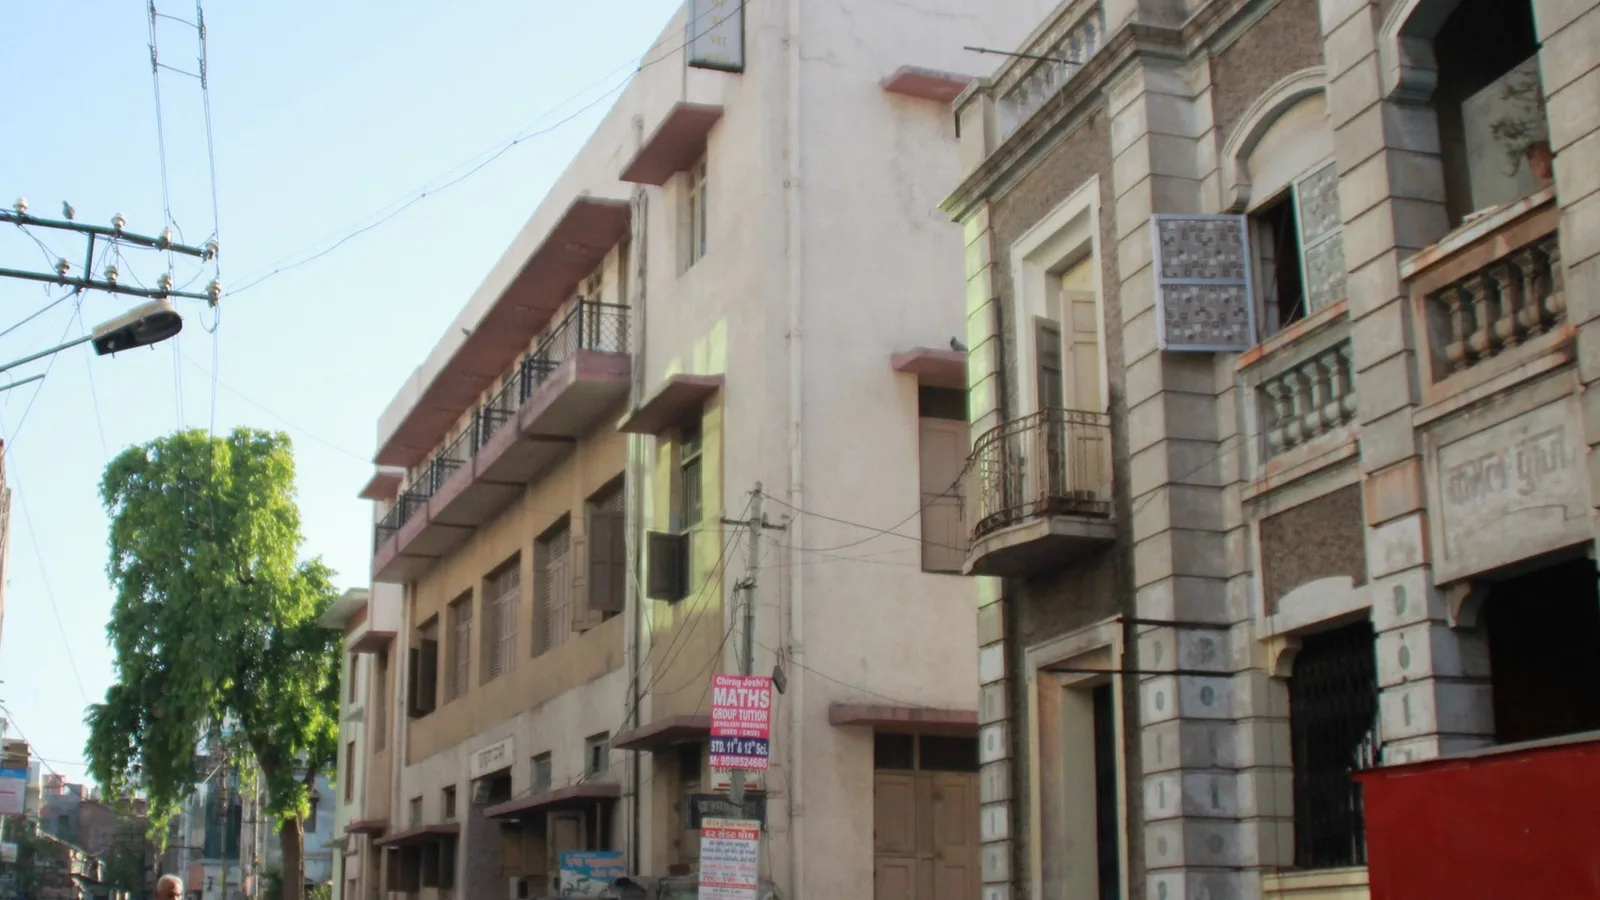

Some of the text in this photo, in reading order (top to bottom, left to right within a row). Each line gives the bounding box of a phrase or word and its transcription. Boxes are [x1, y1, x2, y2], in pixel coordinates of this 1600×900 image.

[716, 676, 769, 688] Chirag Joshi's
[713, 687, 770, 708] MATHS
[712, 707, 768, 721] GROUP TUITION
[711, 740, 725, 752] STD.
[756, 742, 768, 755] Sci.
